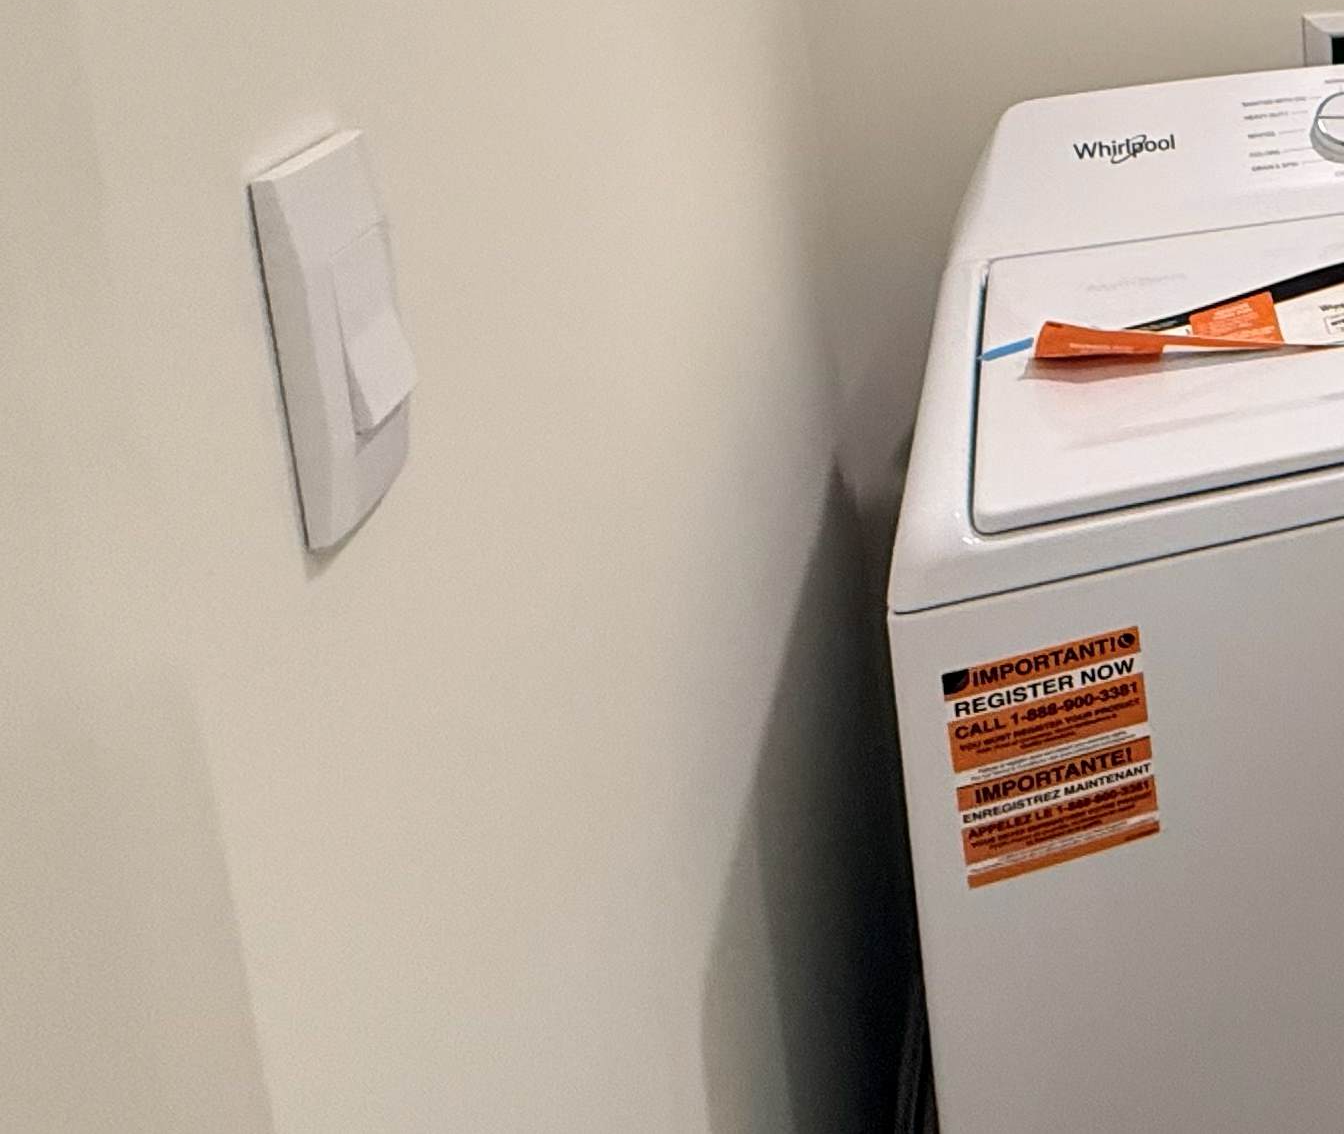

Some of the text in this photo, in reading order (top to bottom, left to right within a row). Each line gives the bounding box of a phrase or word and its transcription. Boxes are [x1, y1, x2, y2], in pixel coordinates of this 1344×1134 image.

[1073, 133, 1175, 164] Whirlpool
[955, 657, 1135, 717] REGISTER NOW
[972, 637, 1116, 687] IMPORTANT!
[955, 716, 1007, 740] CALL
[1010, 681, 1138, 726] 1-888-900-3381
[962, 788, 1061, 823] ENREGISTREZ
[1063, 762, 1152, 796] MAINTENANT
[974, 747, 1133, 804] IMPORTANTE!
